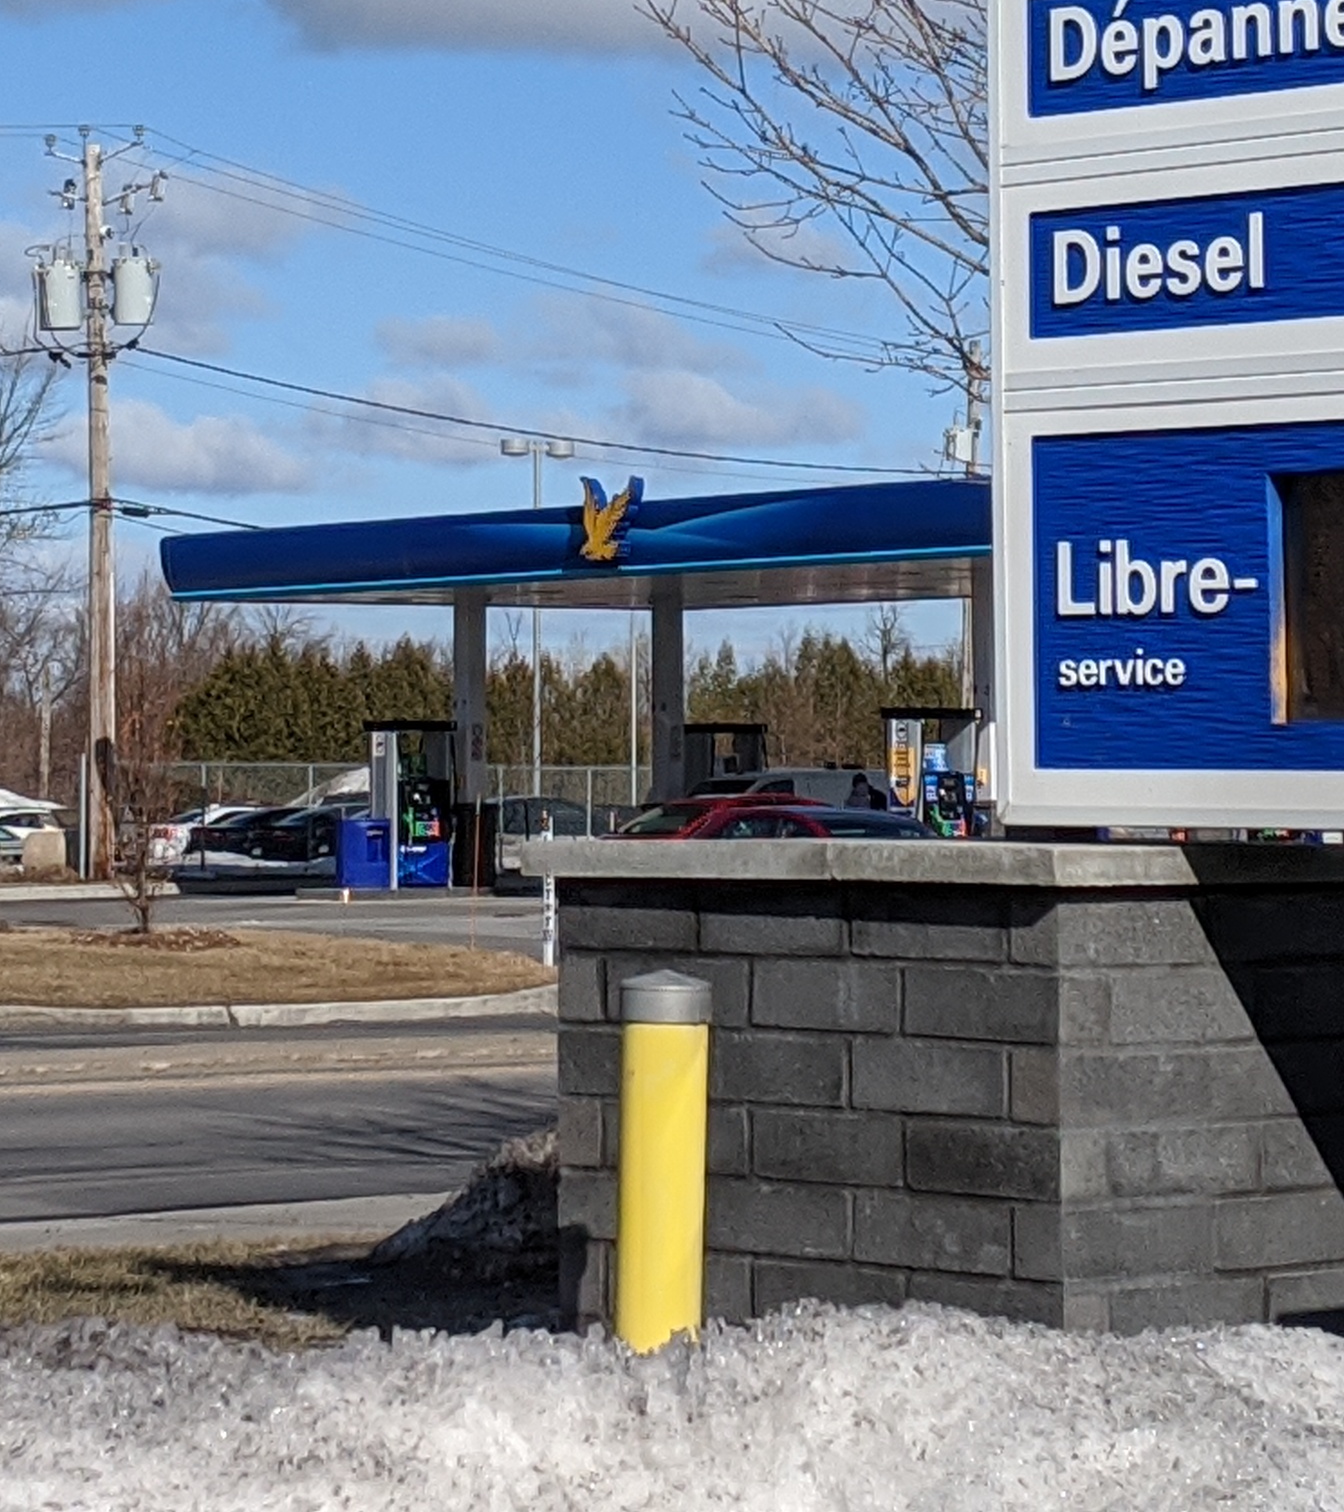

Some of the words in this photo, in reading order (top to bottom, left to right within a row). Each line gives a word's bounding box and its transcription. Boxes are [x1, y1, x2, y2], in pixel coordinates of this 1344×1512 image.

[1052, 210, 1265, 306] Diesel
[1055, 538, 1260, 617] Libre-
[1057, 647, 1187, 688] service
